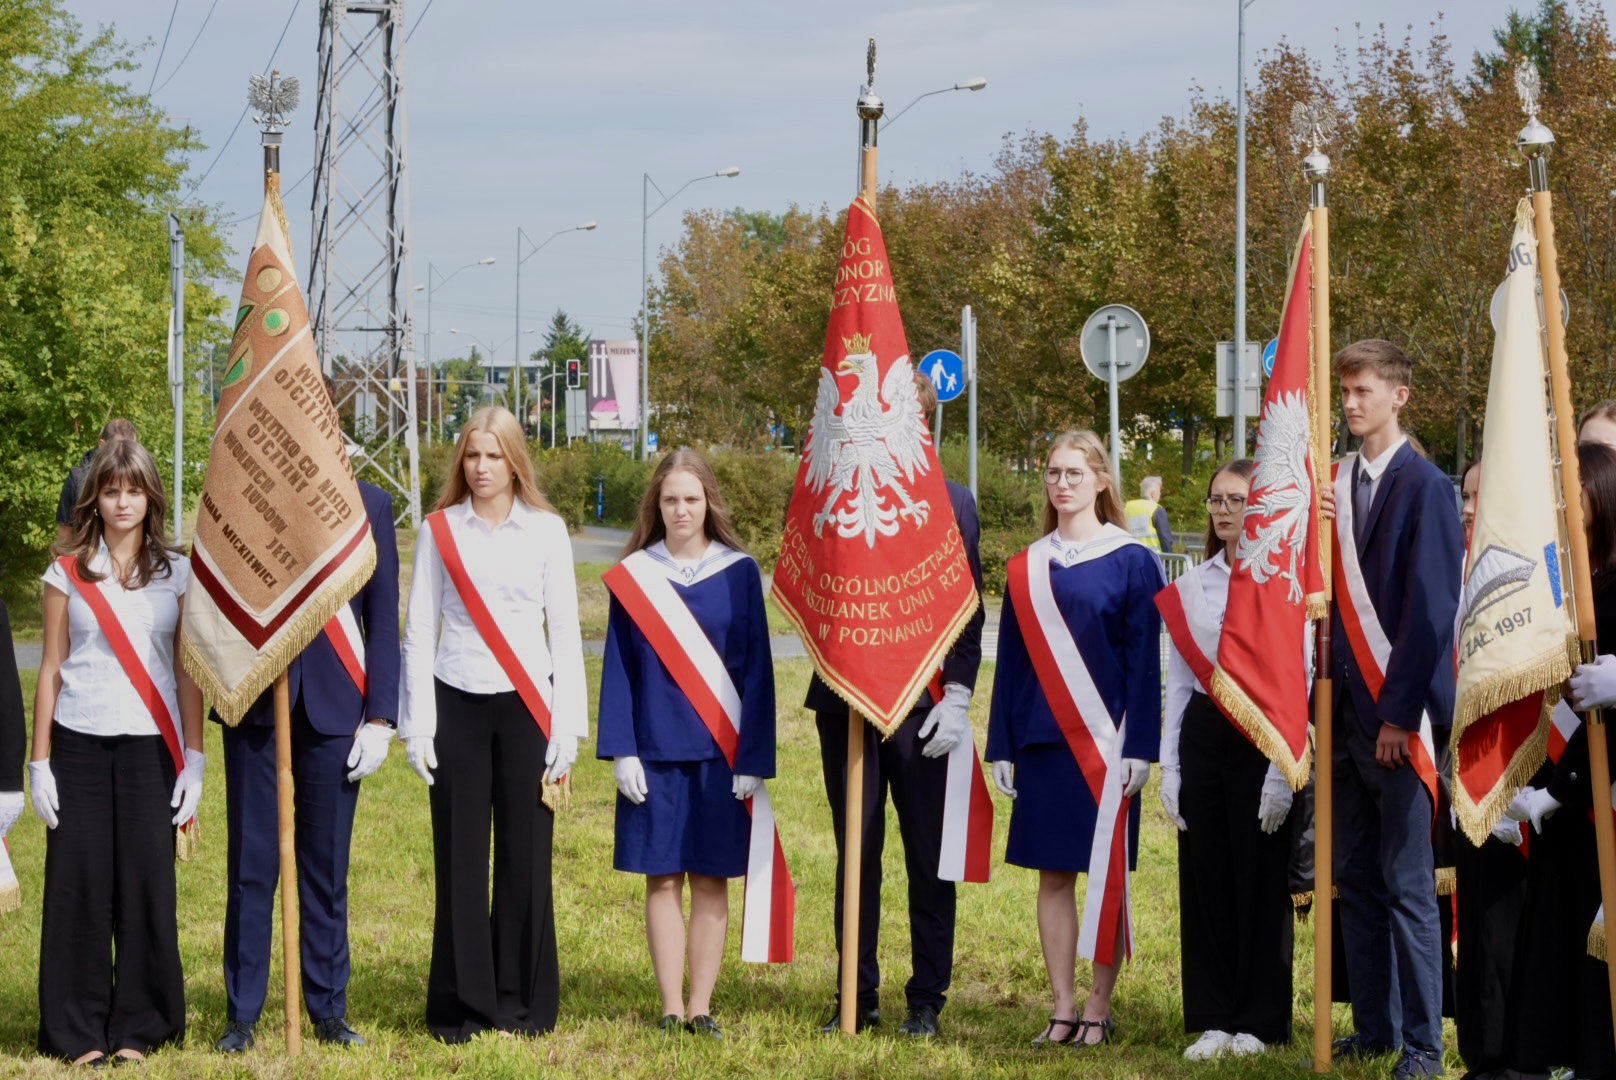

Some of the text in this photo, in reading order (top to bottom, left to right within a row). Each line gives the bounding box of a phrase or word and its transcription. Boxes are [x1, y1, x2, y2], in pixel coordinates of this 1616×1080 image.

[834, 260, 884, 287] ONOR
[841, 236, 870, 259] ÓG
[829, 283, 897, 312] CZYZNA
[274, 368, 336, 440] OJCZYZNY
[223, 430, 276, 495] WOLNYCH
[246, 423, 343, 531] OJCZYZNY JEST
[248, 397, 352, 520] WSZYSTKO CO NASZEJ
[202, 492, 278, 589] ADAM MICKIEWICZ
[785, 517, 815, 576] LICEUM
[780, 542, 801, 586] ÓSTR
[801, 579, 892, 621] URSZULANEK
[899, 586, 935, 615] UNII
[819, 613, 933, 646] W POZNANIU
[1465, 606, 1533, 658] ZAŁ. 1997
